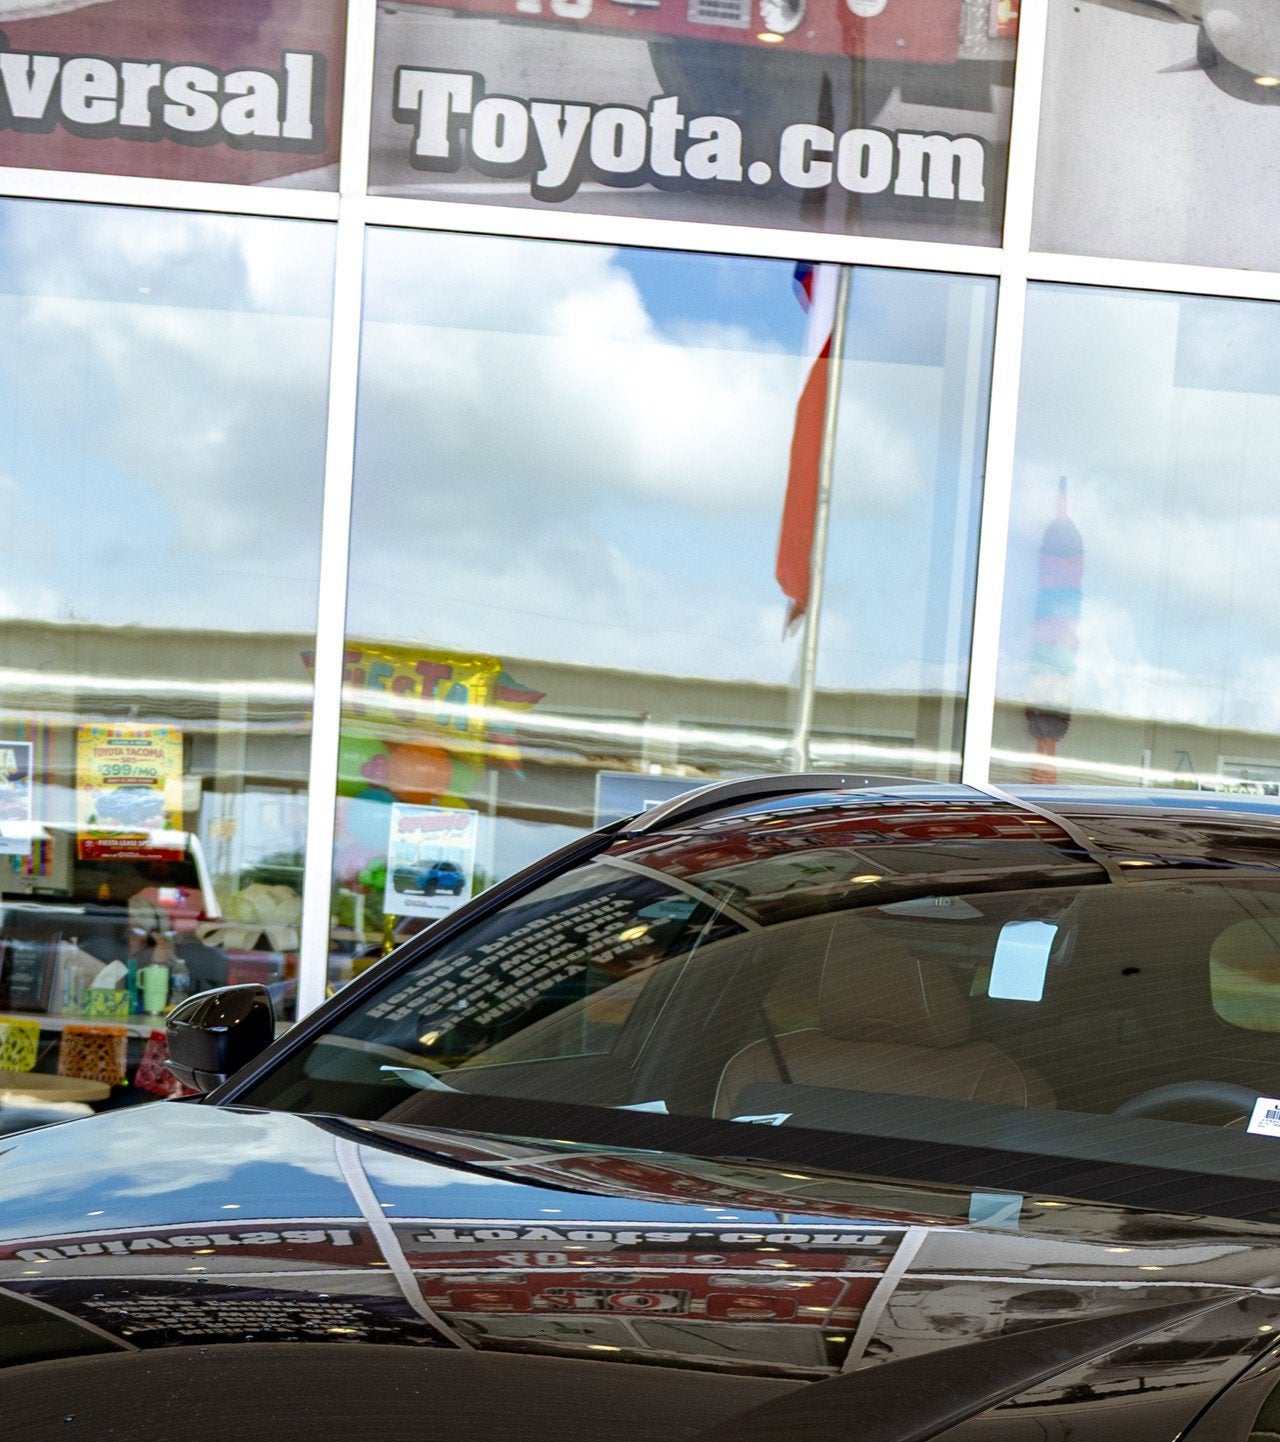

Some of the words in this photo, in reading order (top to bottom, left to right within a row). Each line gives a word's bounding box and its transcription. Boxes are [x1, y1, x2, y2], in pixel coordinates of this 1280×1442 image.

[396, 67, 987, 203] Toyota.com
[93, 747, 124, 758] TOYOTA
[125, 748, 166, 759] TACOMA
